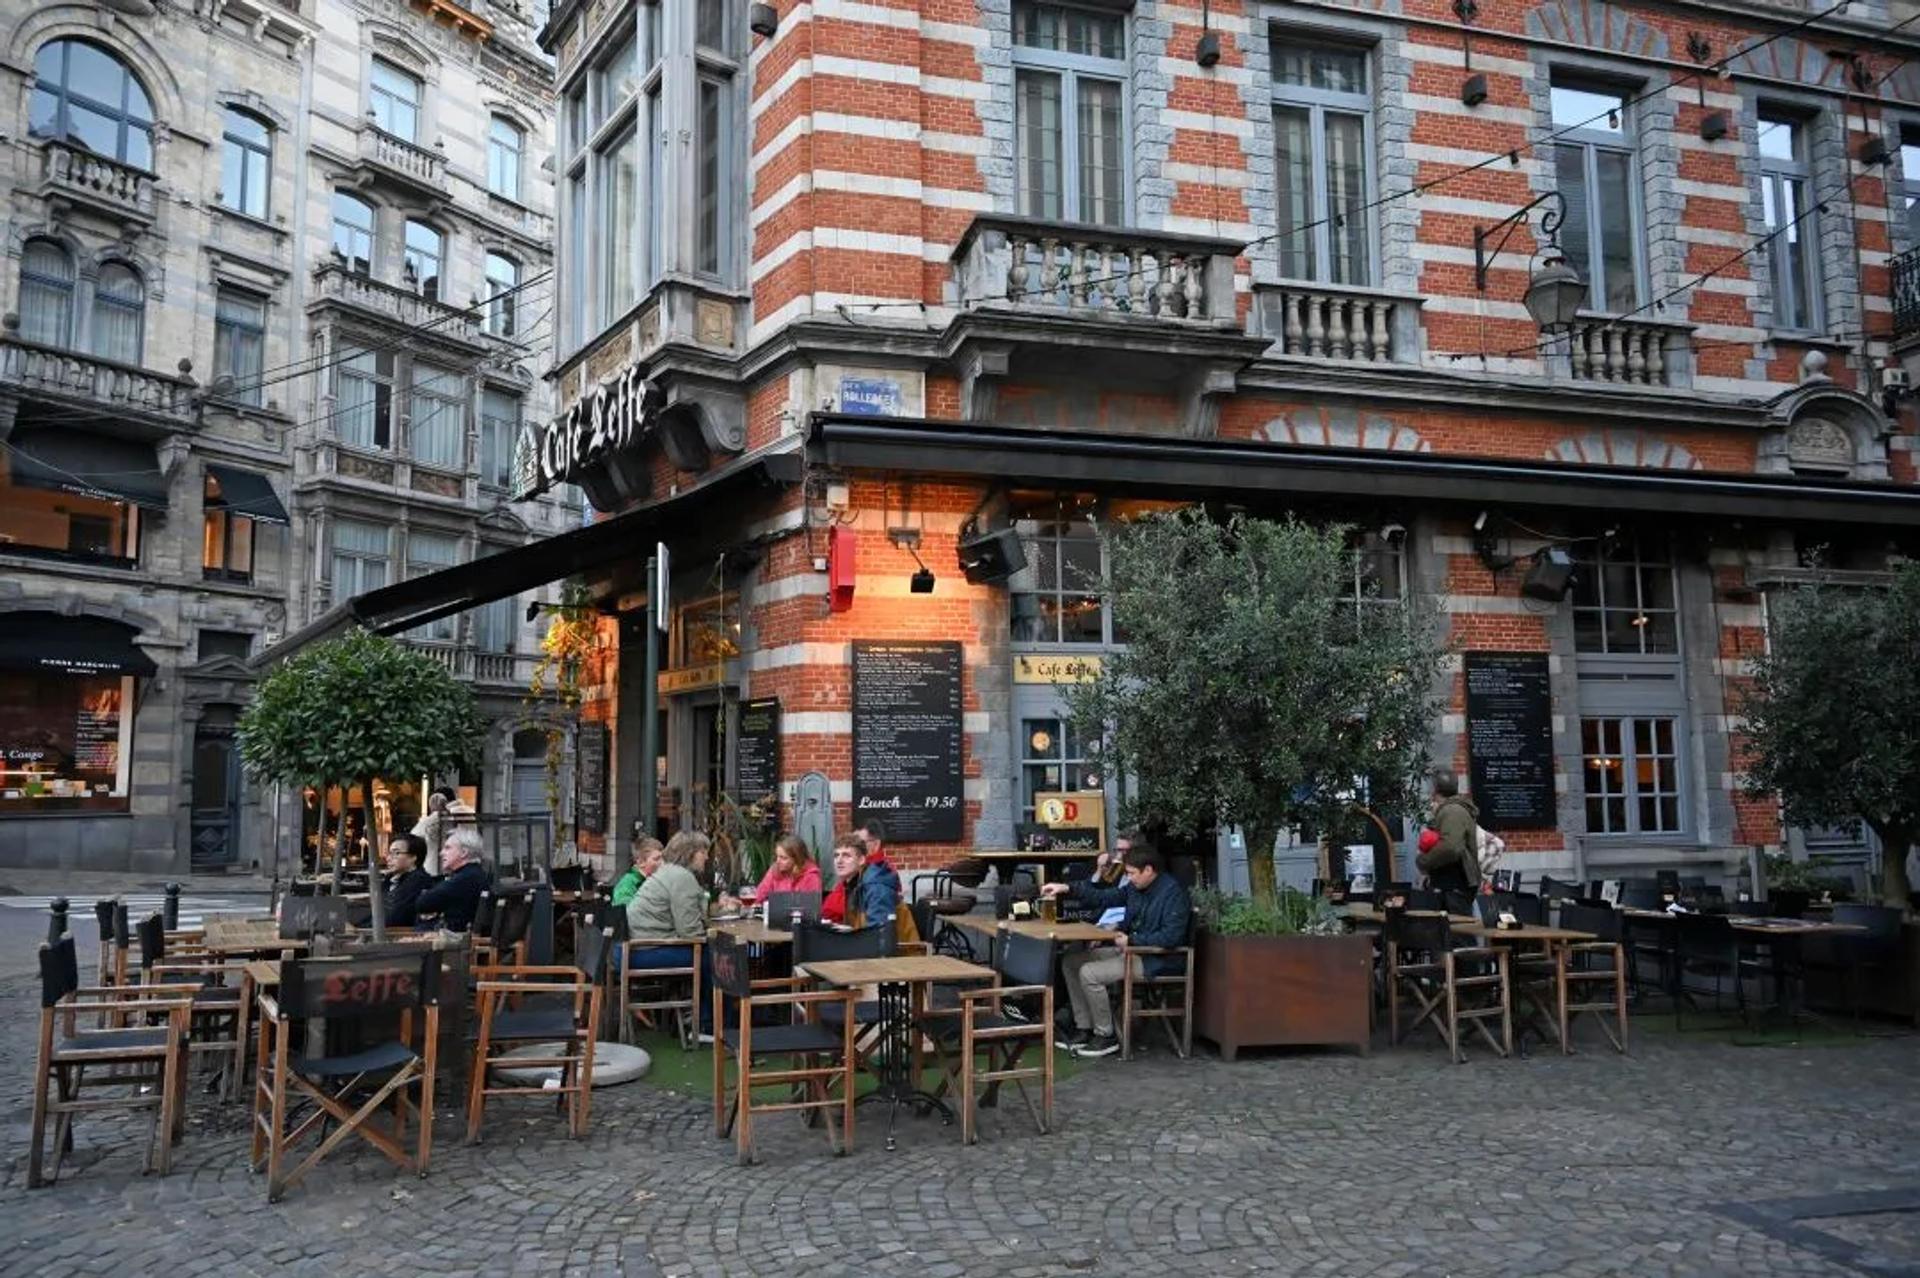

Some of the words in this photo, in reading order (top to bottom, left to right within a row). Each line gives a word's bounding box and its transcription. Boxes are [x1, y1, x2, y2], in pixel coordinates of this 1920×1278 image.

[588, 366, 648, 454] Leffe
[858, 796, 901, 809] Lunch
[924, 796, 958, 809] 19.50
[320, 968, 413, 1005] Leffe
